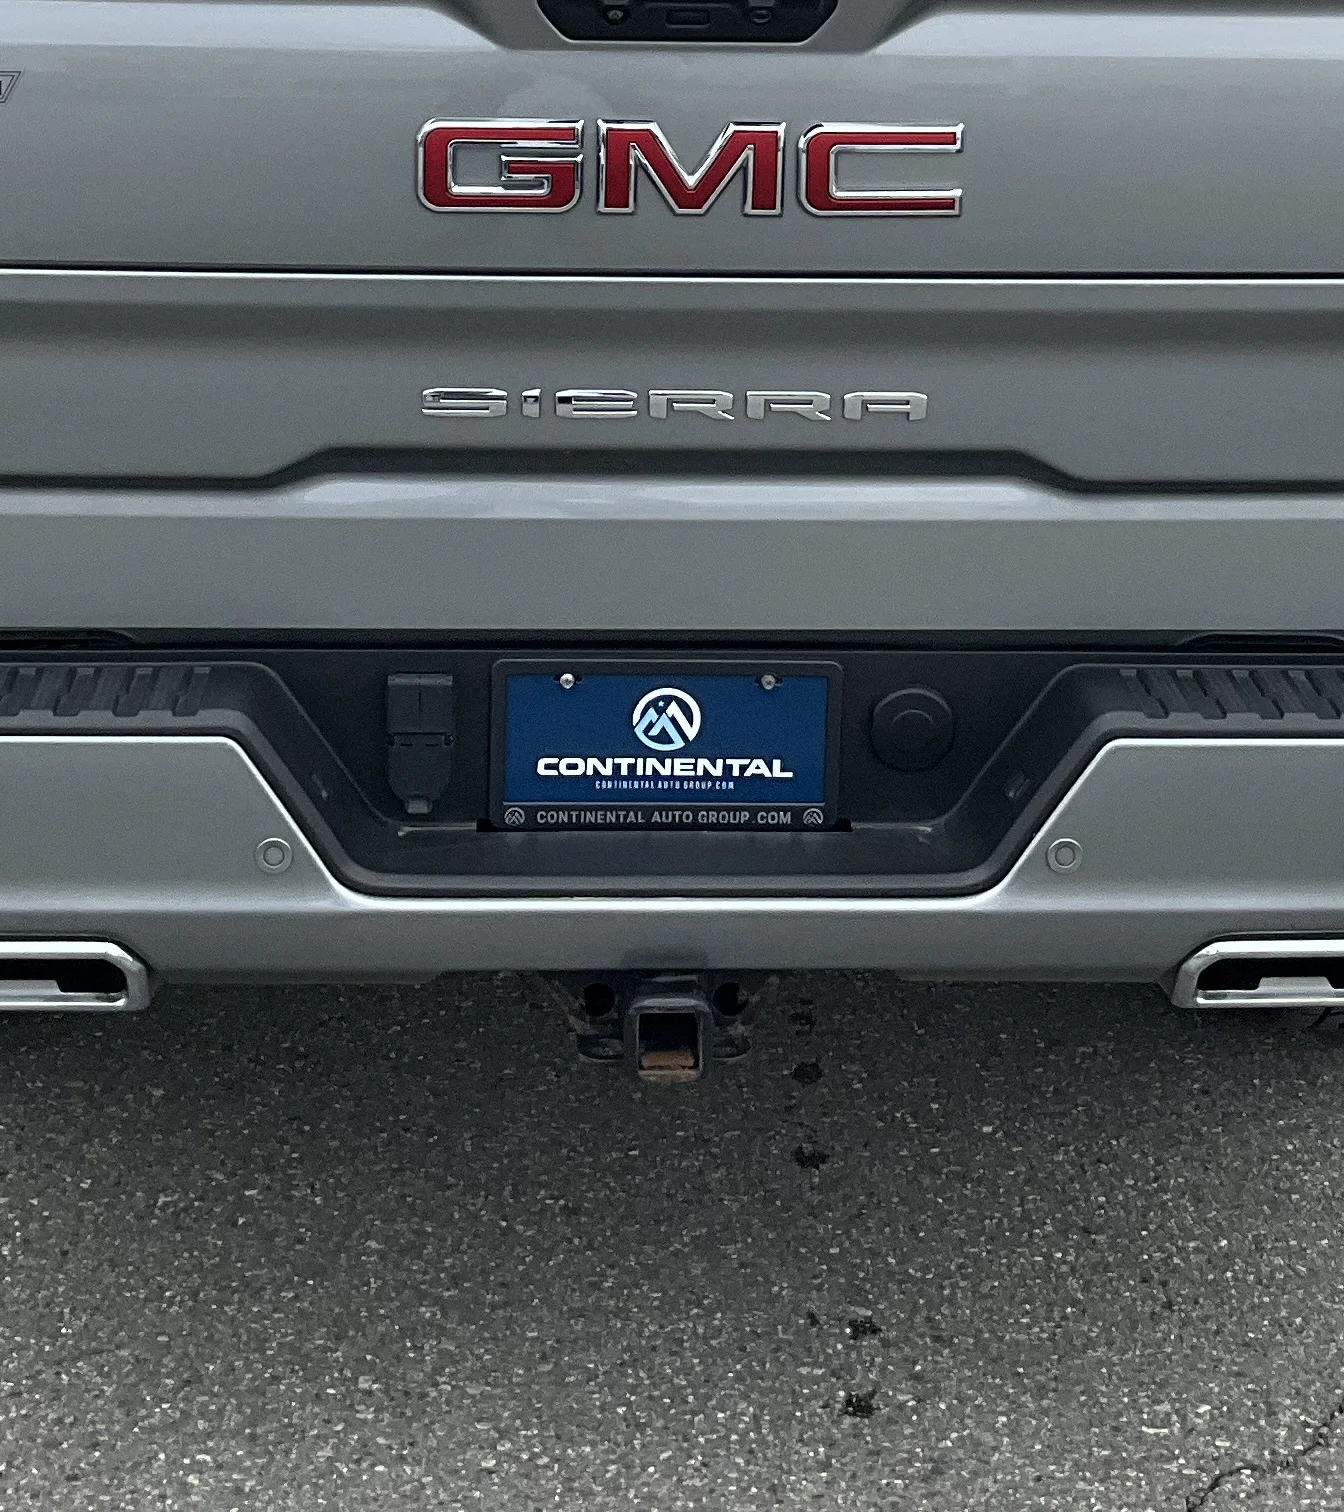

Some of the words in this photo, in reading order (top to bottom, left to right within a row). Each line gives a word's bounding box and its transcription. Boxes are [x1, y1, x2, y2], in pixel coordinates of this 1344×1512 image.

[416, 117, 965, 218] GMC
[421, 387, 929, 421] SIERRA
[536, 757, 794, 778] CONTINENTAL
[595, 780, 655, 790] CONTINENTAL
[657, 780, 681, 790] AUTO
[536, 810, 646, 824] CONTINENTAL
[651, 810, 694, 825] AUTO
